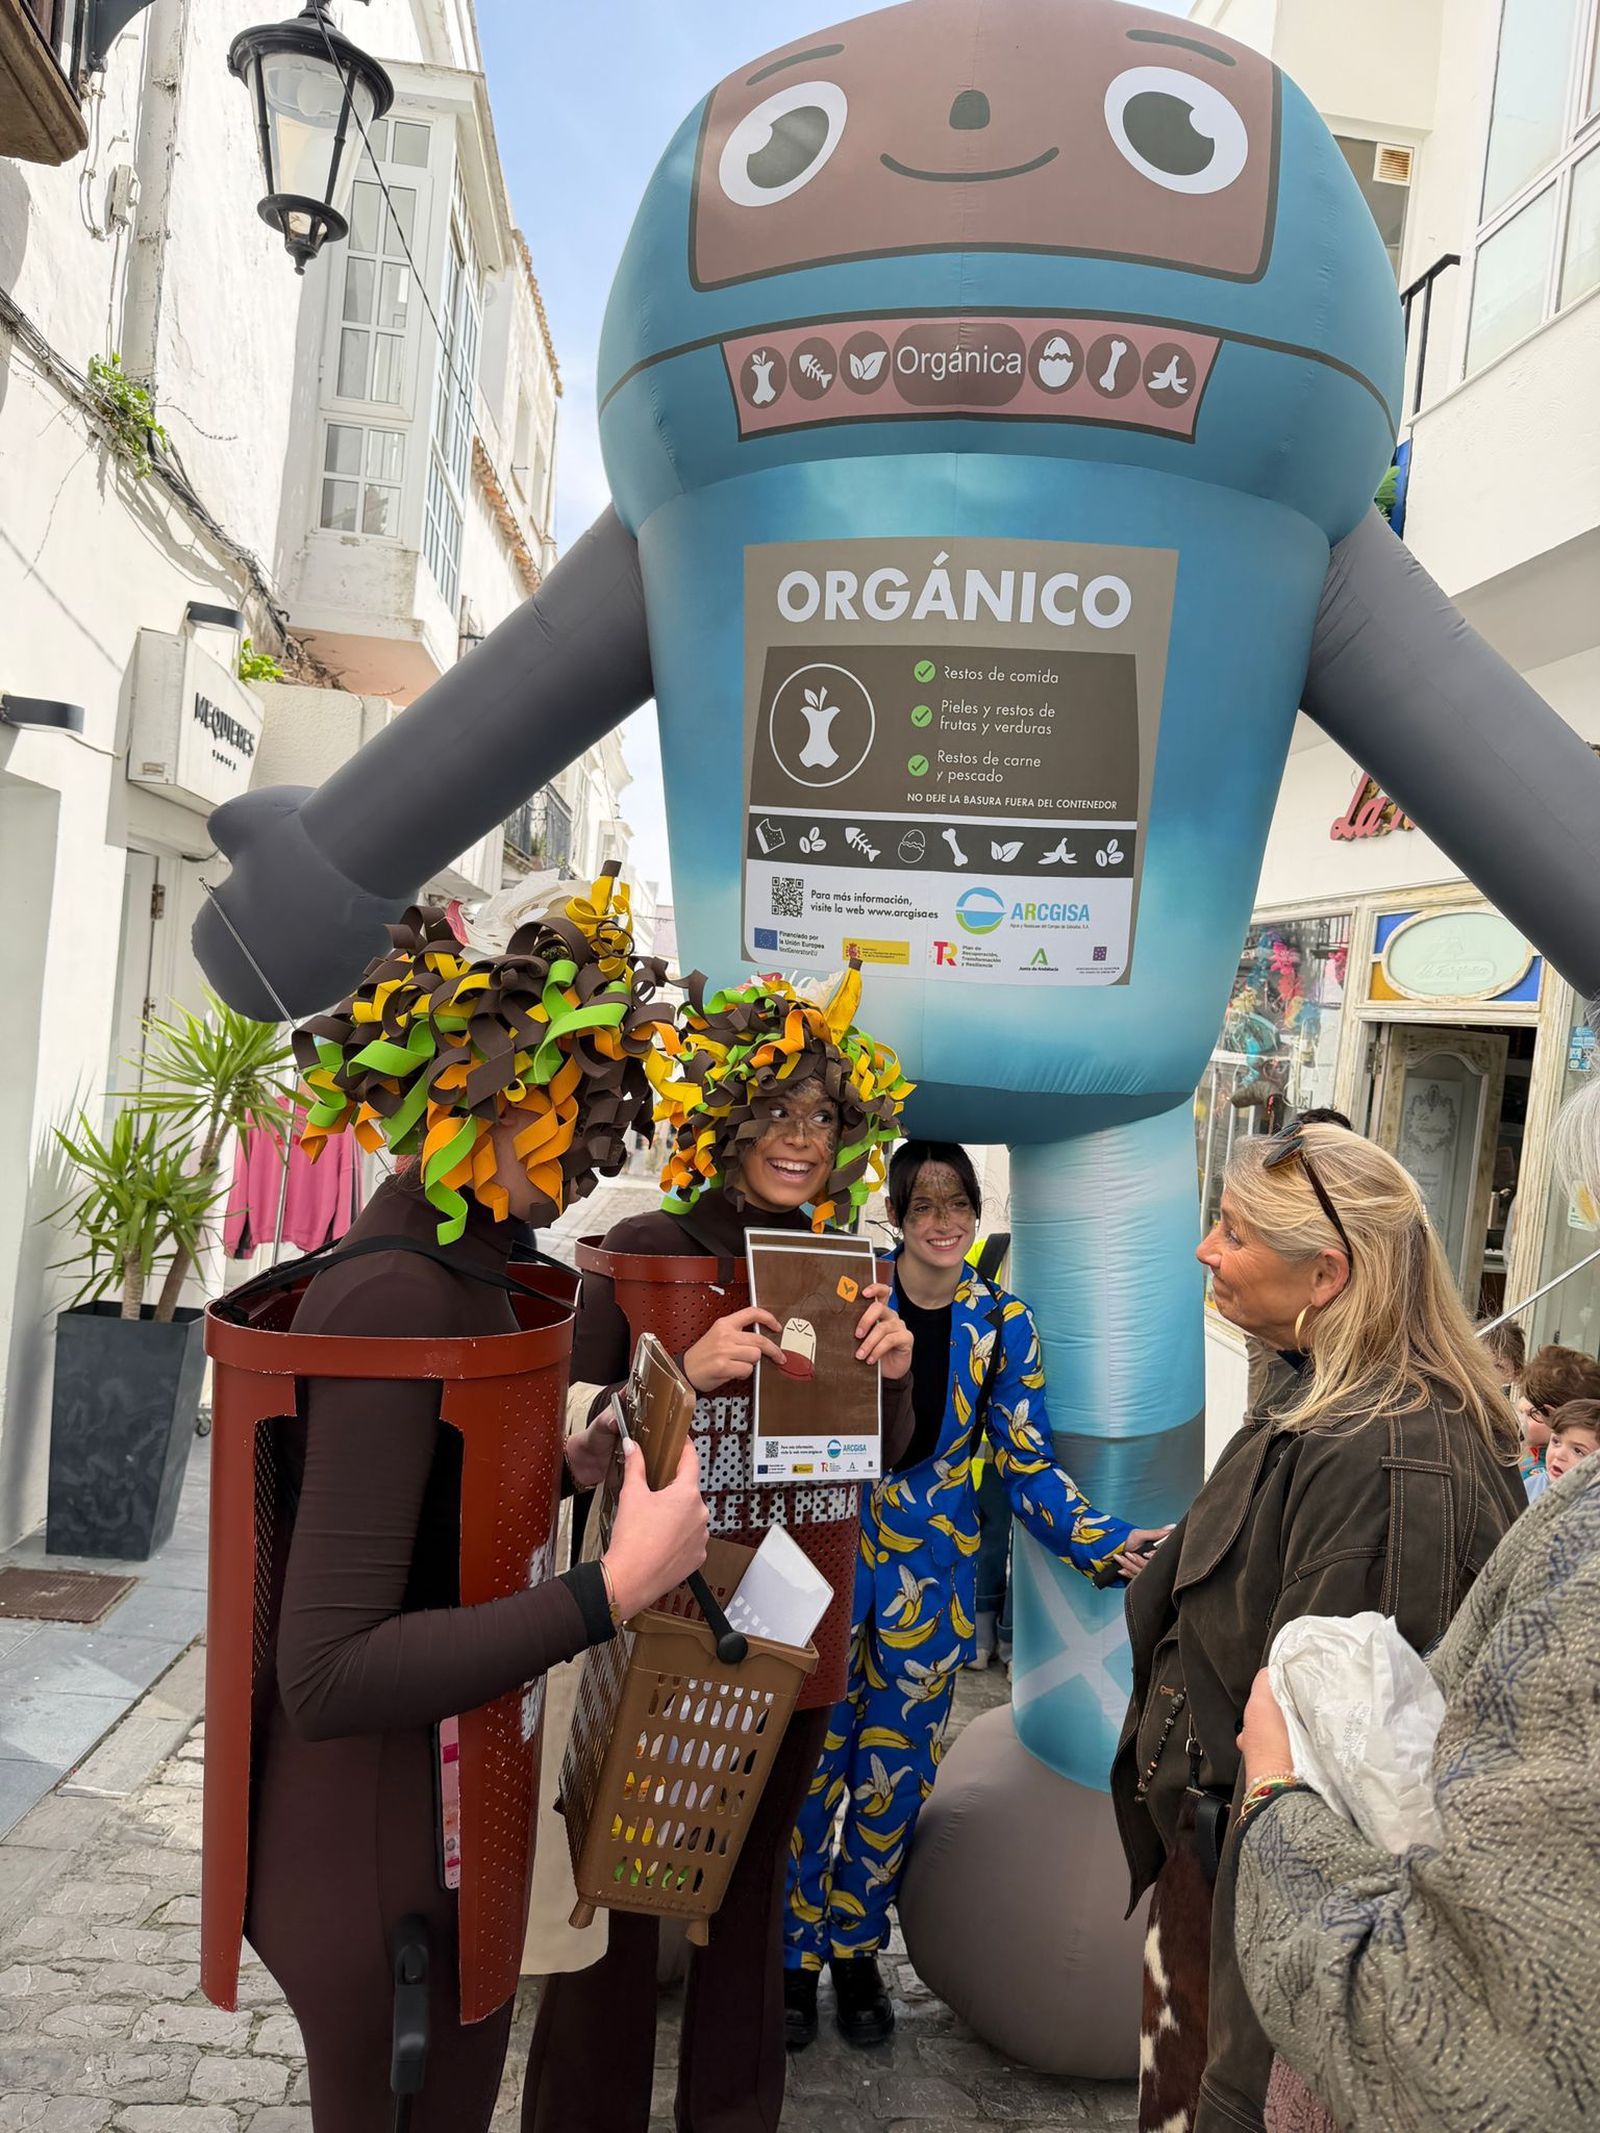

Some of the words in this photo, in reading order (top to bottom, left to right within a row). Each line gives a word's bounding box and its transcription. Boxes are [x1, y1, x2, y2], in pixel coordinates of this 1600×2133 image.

[897, 345, 1021, 381] Orgánica
[777, 551, 1132, 629] ORGÁNICO
[944, 665, 983, 680] Restos
[988, 666, 1005, 681] de
[1010, 669, 1059, 684] comida
[941, 699, 978, 714] Pieles
[983, 705, 991, 718] y
[996, 705, 1034, 717] restos
[1039, 703, 1055, 717] de
[940, 715, 977, 731] frutas
[981, 722, 990, 735] y
[994, 720, 1052, 735] verduras
[937, 750, 978, 764] Restos
[983, 751, 999, 765] de
[1004, 757, 1041, 768] carne
[936, 771, 943, 782] y
[948, 769, 1003, 783] pescado
[907, 793, 923, 802] NO
[926, 794, 946, 803] DEJE
[950, 795, 960, 804] LA
[964, 795, 1001, 806] BASURA
[1005, 798, 1034, 808] FUERA
[1038, 799, 1053, 808] DEL
[1056, 800, 1117, 810] CONTENEDOR
[811, 890, 830, 900] Para
[833, 891, 851, 902] más
[854, 892, 912, 906] información,
[810, 903, 832, 913] visite
[835, 904, 843, 914] la
[845, 905, 865, 915] web
[1010, 902, 1090, 922] ARCGISA
[691, 1396, 750, 1432] STE
[706, 1494, 744, 1531] LE
[749, 1492, 787, 1528] LA
[794, 1486, 857, 1524] PENA
